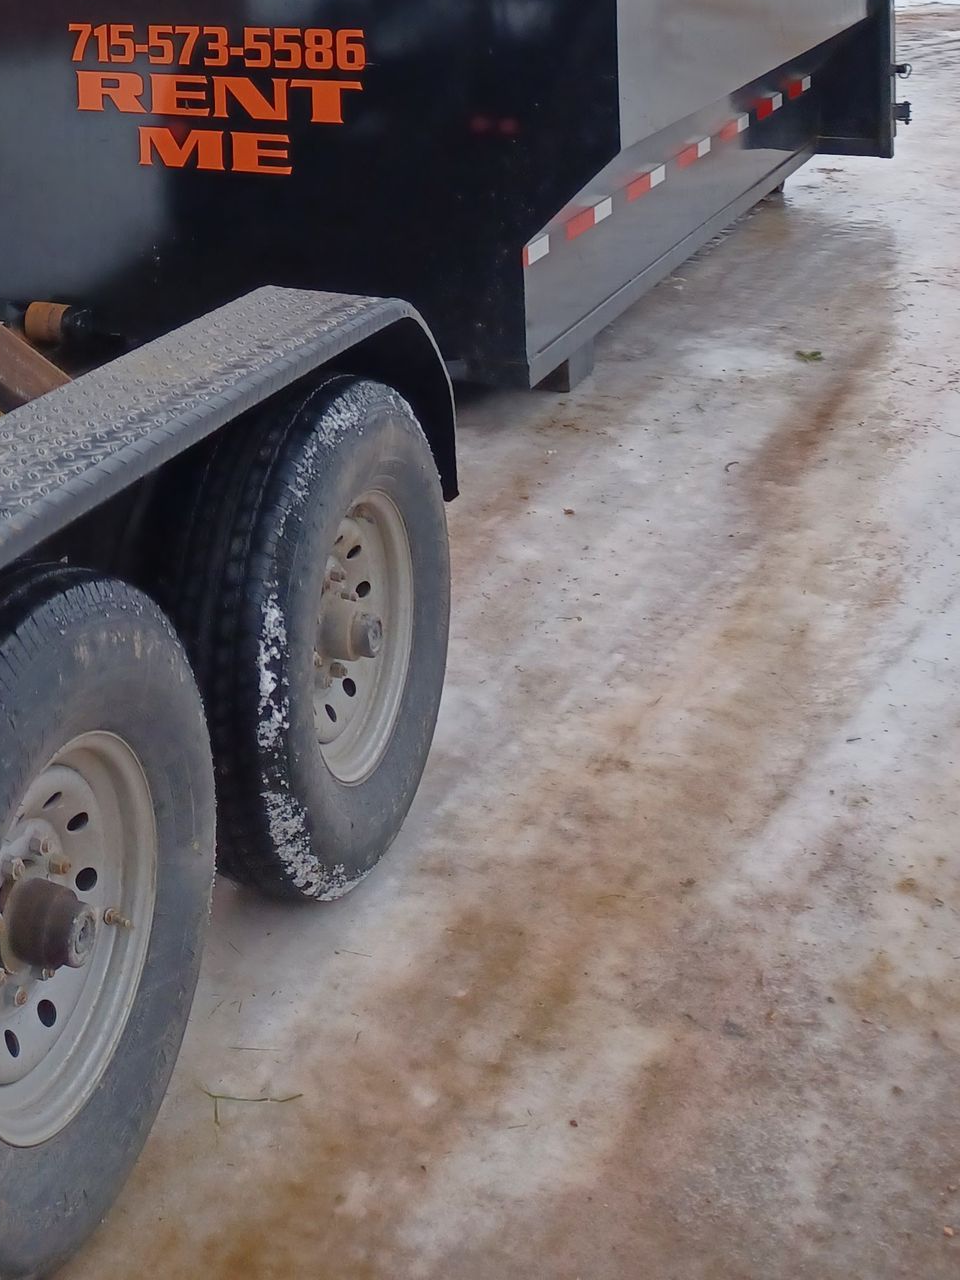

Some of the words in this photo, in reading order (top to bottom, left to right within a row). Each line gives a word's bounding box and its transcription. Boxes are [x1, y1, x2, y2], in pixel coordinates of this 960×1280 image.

[68, 23, 366, 72] 715-573-5586
[75, 70, 363, 124] RENT
[138, 126, 293, 175] ME
